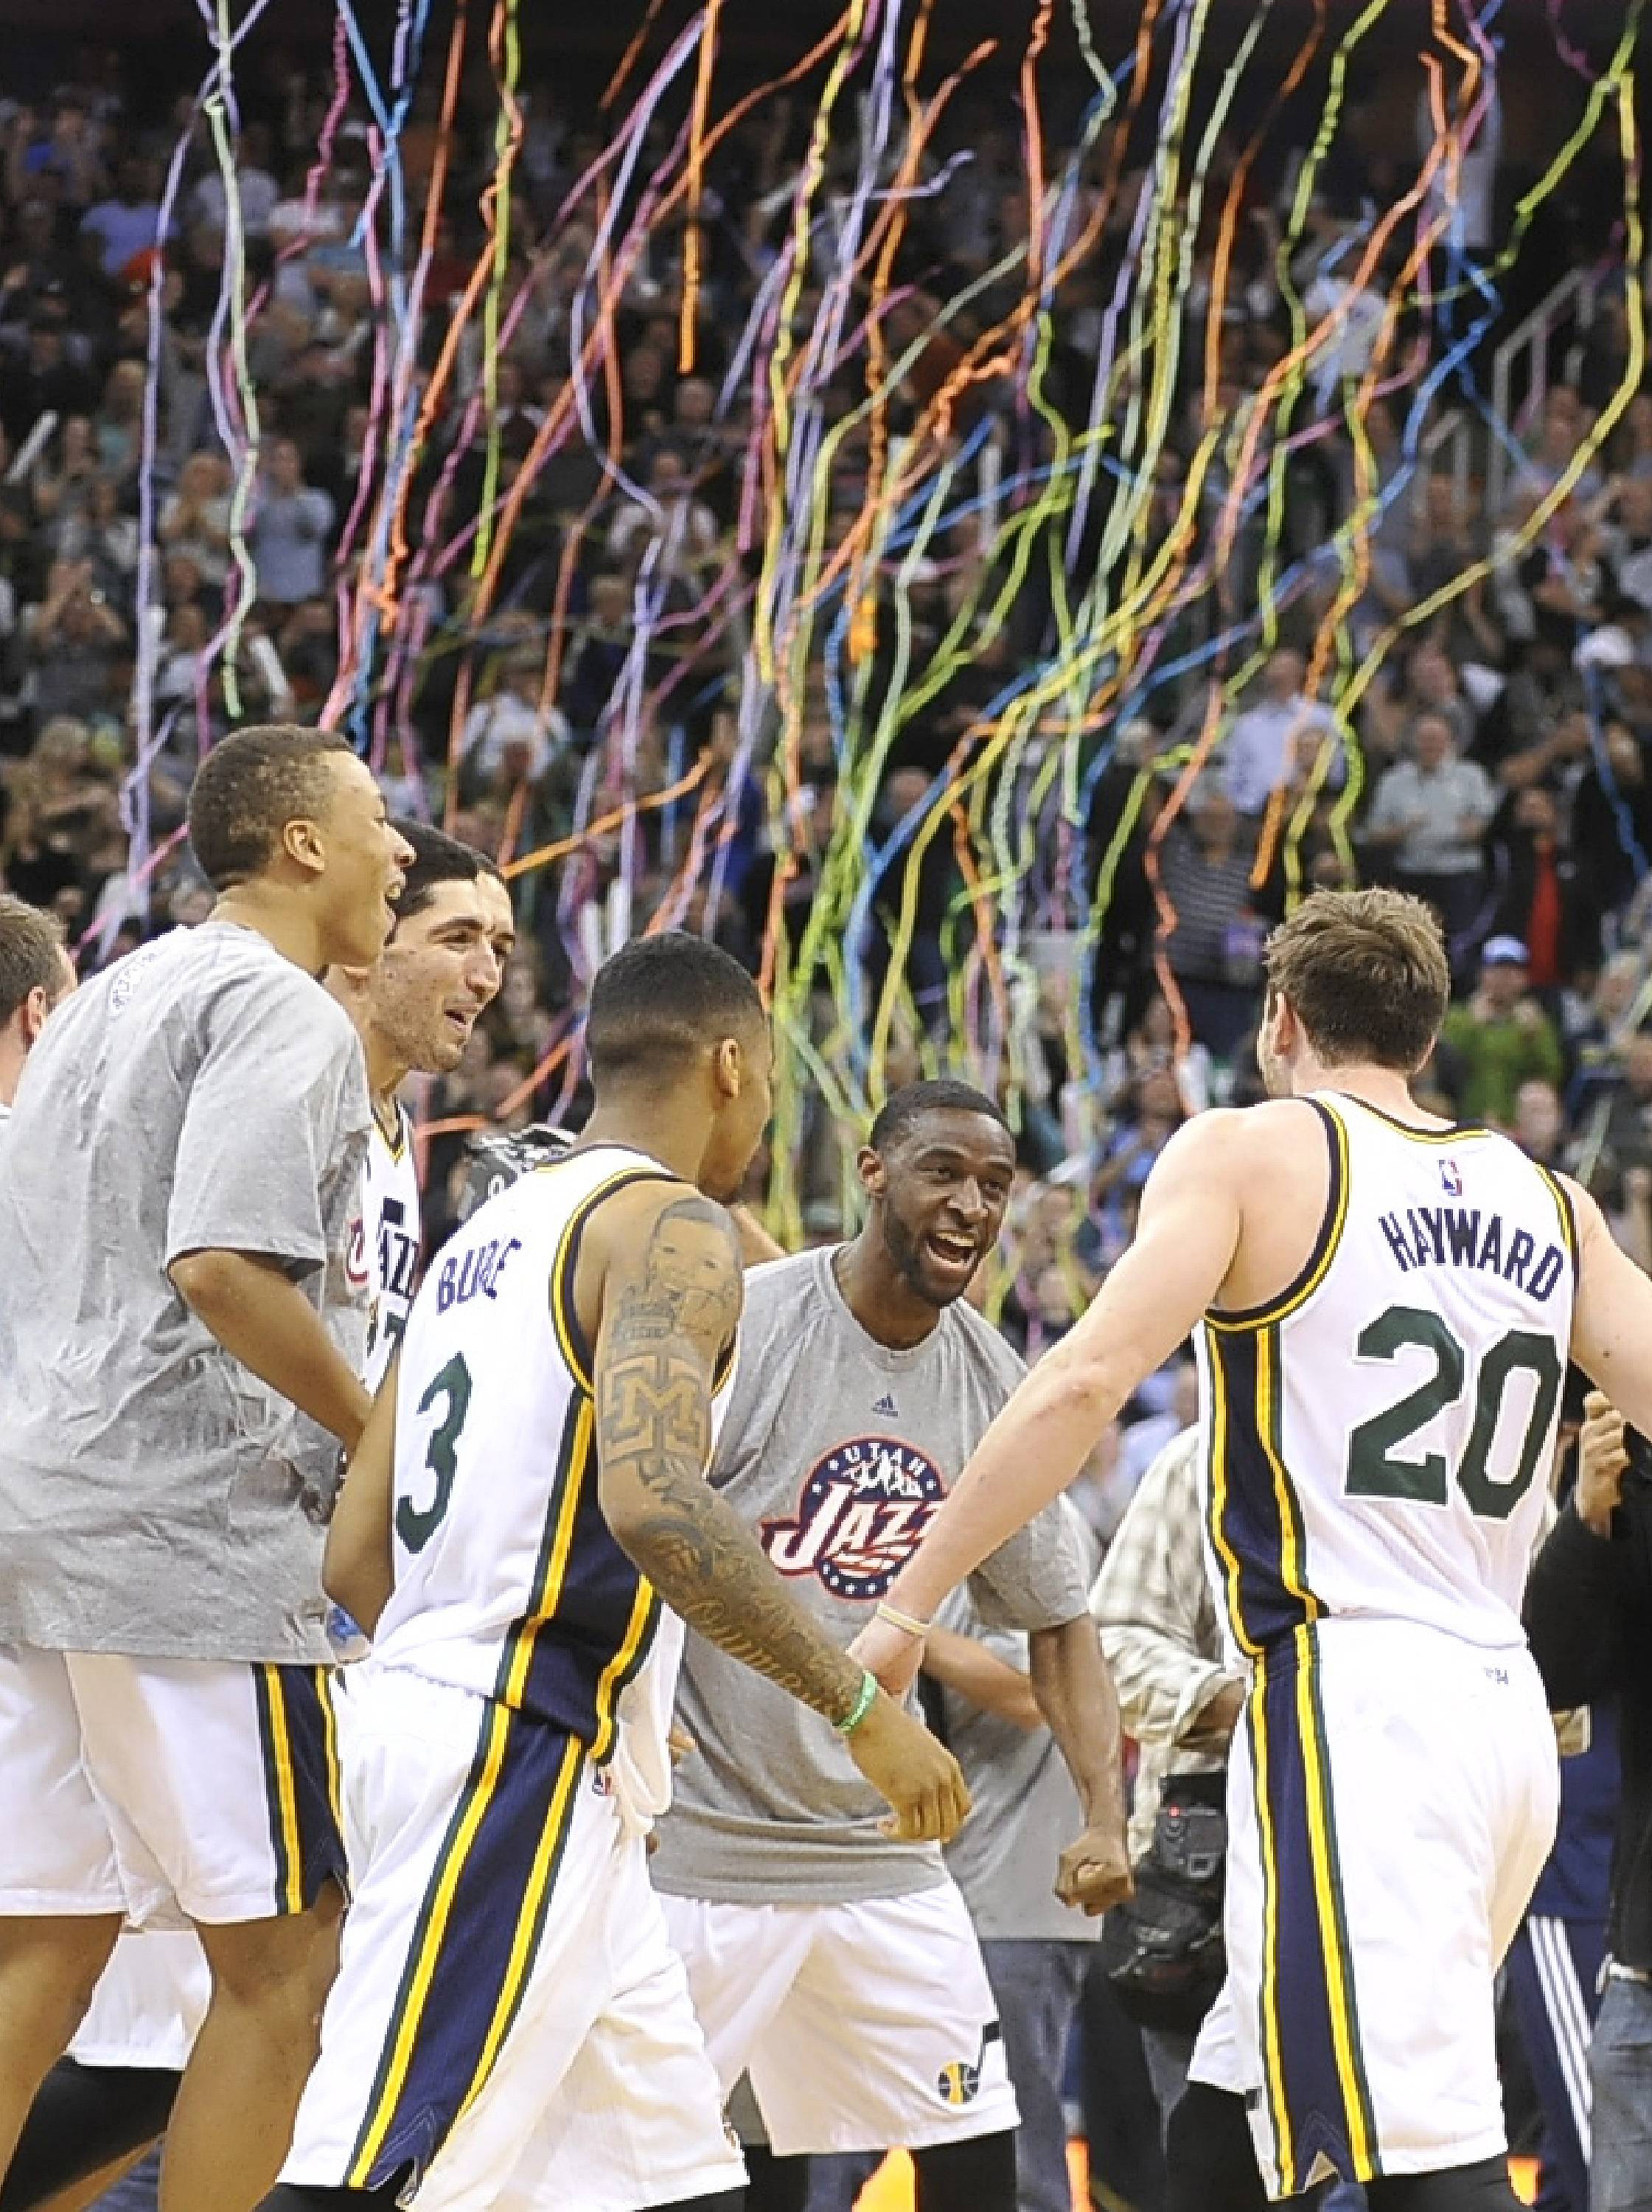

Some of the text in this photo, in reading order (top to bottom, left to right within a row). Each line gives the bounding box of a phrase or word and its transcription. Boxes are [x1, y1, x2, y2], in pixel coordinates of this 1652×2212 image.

[1378, 1207, 1564, 1302] HAYWARD
[396, 1351, 473, 1554] 3
[843, 1442, 927, 1477] UTAH
[1345, 1304, 1562, 1521] 20
